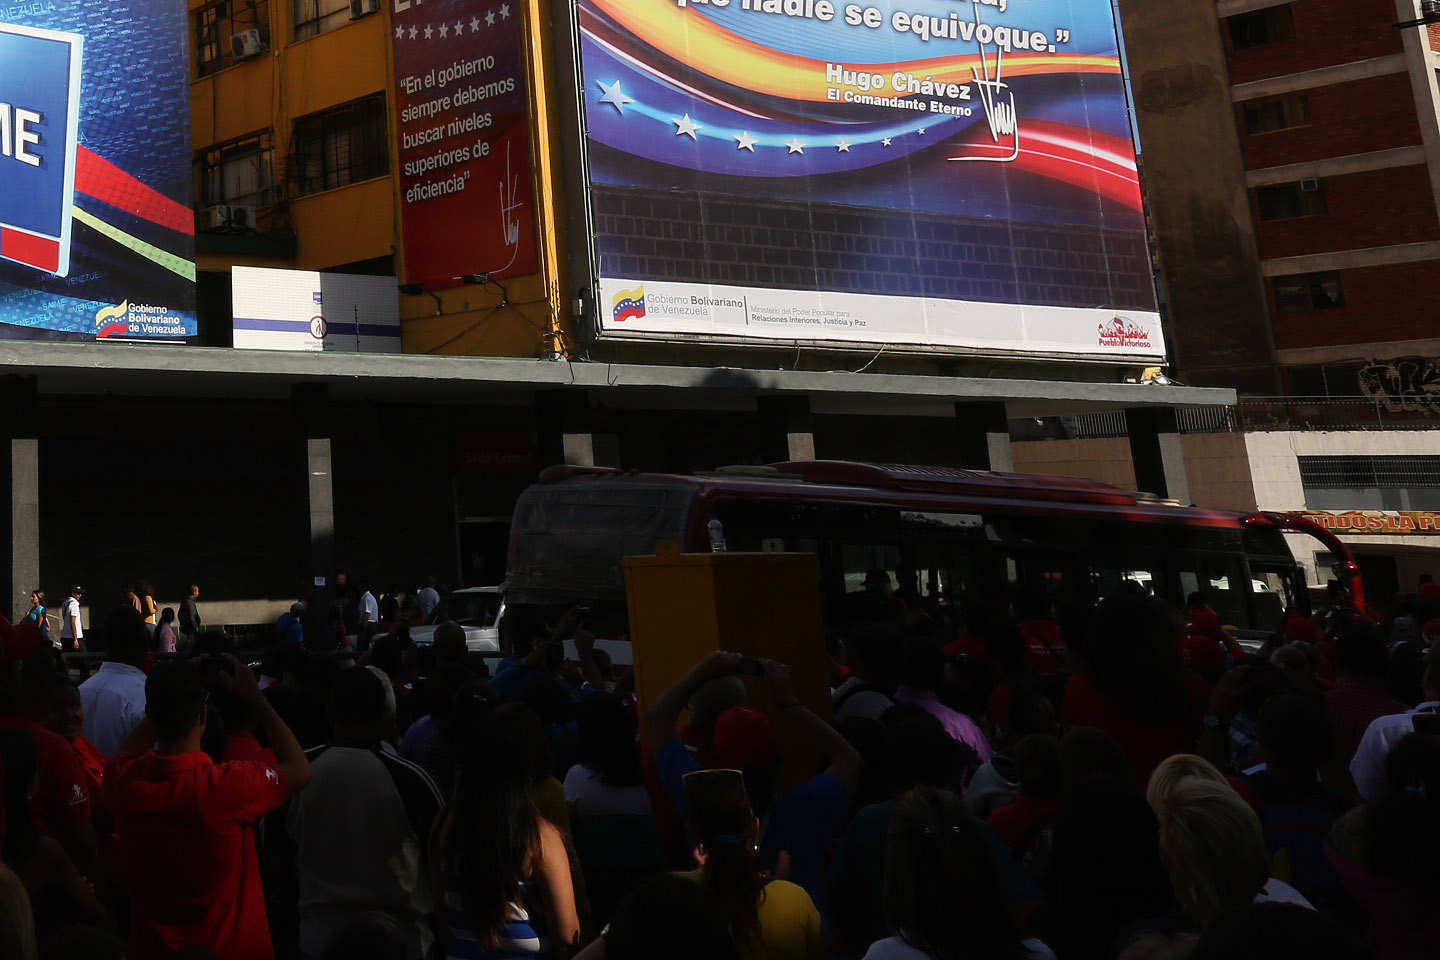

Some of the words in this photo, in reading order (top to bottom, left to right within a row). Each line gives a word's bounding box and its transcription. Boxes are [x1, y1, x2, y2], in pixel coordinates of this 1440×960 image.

[844, 1, 882, 28] se
[891, 10, 1070, 53] equivoque.”
[400, 76, 422, 95] “En
[424, 69, 435, 88] el
[438, 55, 495, 88] gobierno
[825, 63, 886, 92] Hugo
[891, 71, 972, 101] Chávez
[402, 96, 451, 123] siempre
[453, 77, 515, 107] debemos
[827, 88, 840, 100] El
[843, 91, 927, 113] Comandante
[930, 100, 972, 117] Eterno
[403, 123, 445, 150] buscar
[448, 112, 492, 137] niveles
[404, 145, 470, 176] superiores
[473, 139, 490, 158] de
[406, 170, 471, 203] eficiencia”
[42, 298, 66, 310] SAIME
[647, 293, 689, 305] Gobierno
[691, 295, 743, 308] Bolivariano
[128, 303, 168, 315] Gobierno
[648, 305, 660, 314] de
[662, 305, 708, 316] Venezuela
[750, 305, 780, 314] Ministerio
[782, 307, 791, 315] del
[792, 308, 810, 316] Poder
[811, 309, 835, 318] Popular
[836, 310, 850, 318] para
[128, 313, 180, 325] Bolivariano
[751, 314, 788, 323] Relaciones
[789, 315, 823, 325] Interiores,
[823, 317, 848, 326] Justicia
[854, 319, 866, 327] Paz
[128, 324, 140, 333] de
[142, 324, 186, 335] Venezuela
[1387, 515, 1416, 530] LA
